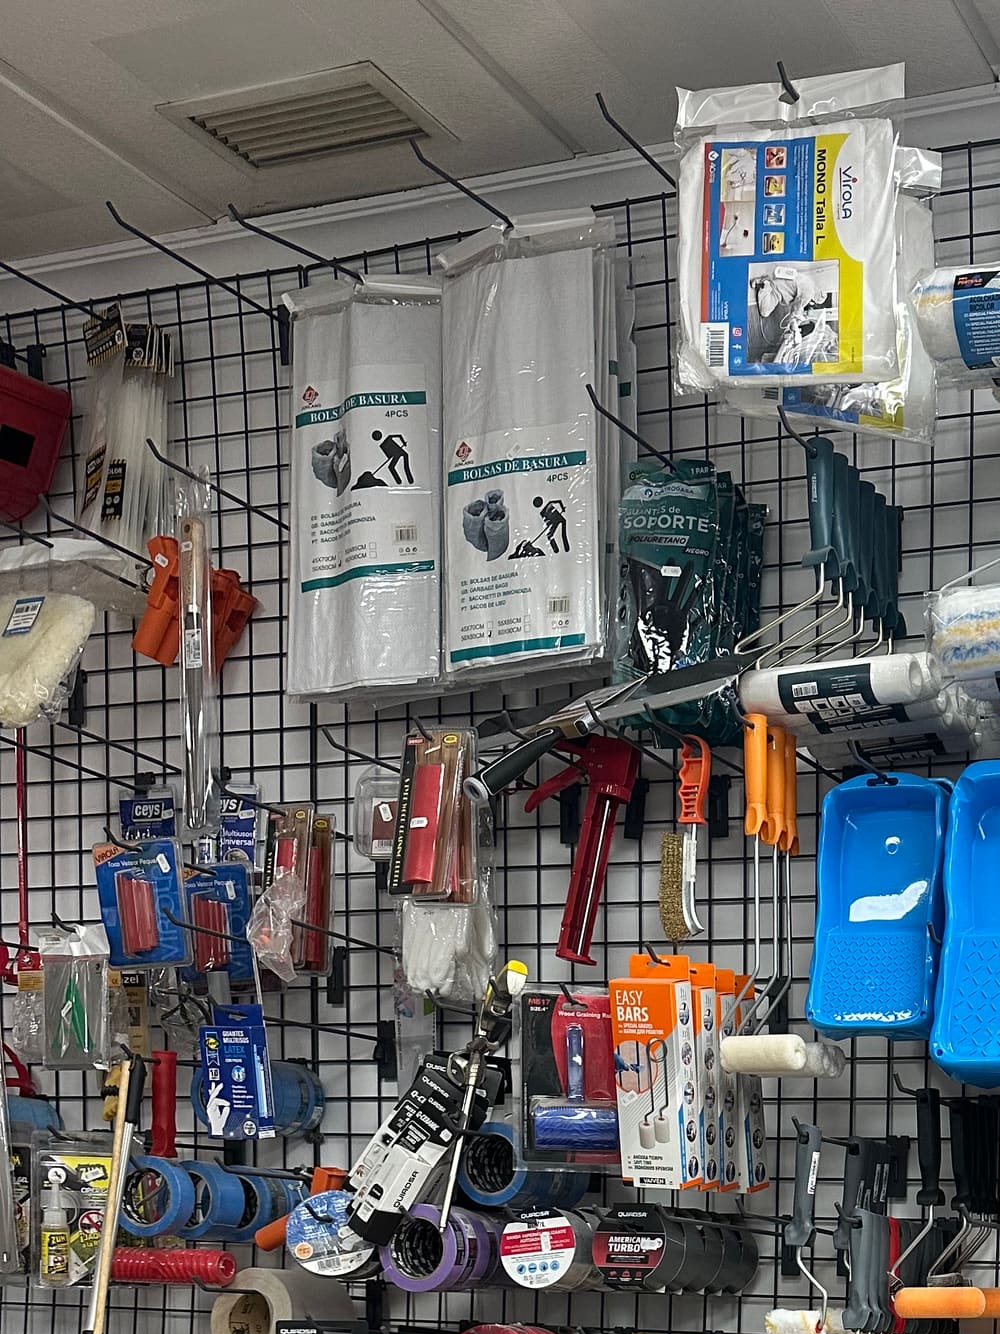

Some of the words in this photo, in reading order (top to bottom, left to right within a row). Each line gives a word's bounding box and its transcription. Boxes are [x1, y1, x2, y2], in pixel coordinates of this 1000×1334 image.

[816, 148, 827, 194] MONO
[816, 198, 826, 231] Talla
[815, 235, 826, 246] L
[969, 302, 995, 311] BICOLOR
[359, 393, 408, 405] BASURA
[384, 409, 409, 418] 4PCS
[463, 465, 502, 481] BOLSAS
[503, 460, 520, 473] DE
[522, 455, 569, 470] BASURA
[695, 466, 709, 475] PAR
[546, 472, 569, 482] 4PCS
[668, 505, 681, 513] de
[622, 514, 710, 533] SOPORTE
[685, 547, 710, 557] NEGRO
[134, 803, 161, 818] ceys
[95, 846, 119, 864] VIROLA
[615, 990, 643, 1006] EASY
[558, 1010, 575, 1018] Wood
[576, 1011, 601, 1020] Graining
[617, 1006, 650, 1022] BARS
[224, 1046, 246, 1054] LATEX
[608, 1243, 641, 1253] TURBO
